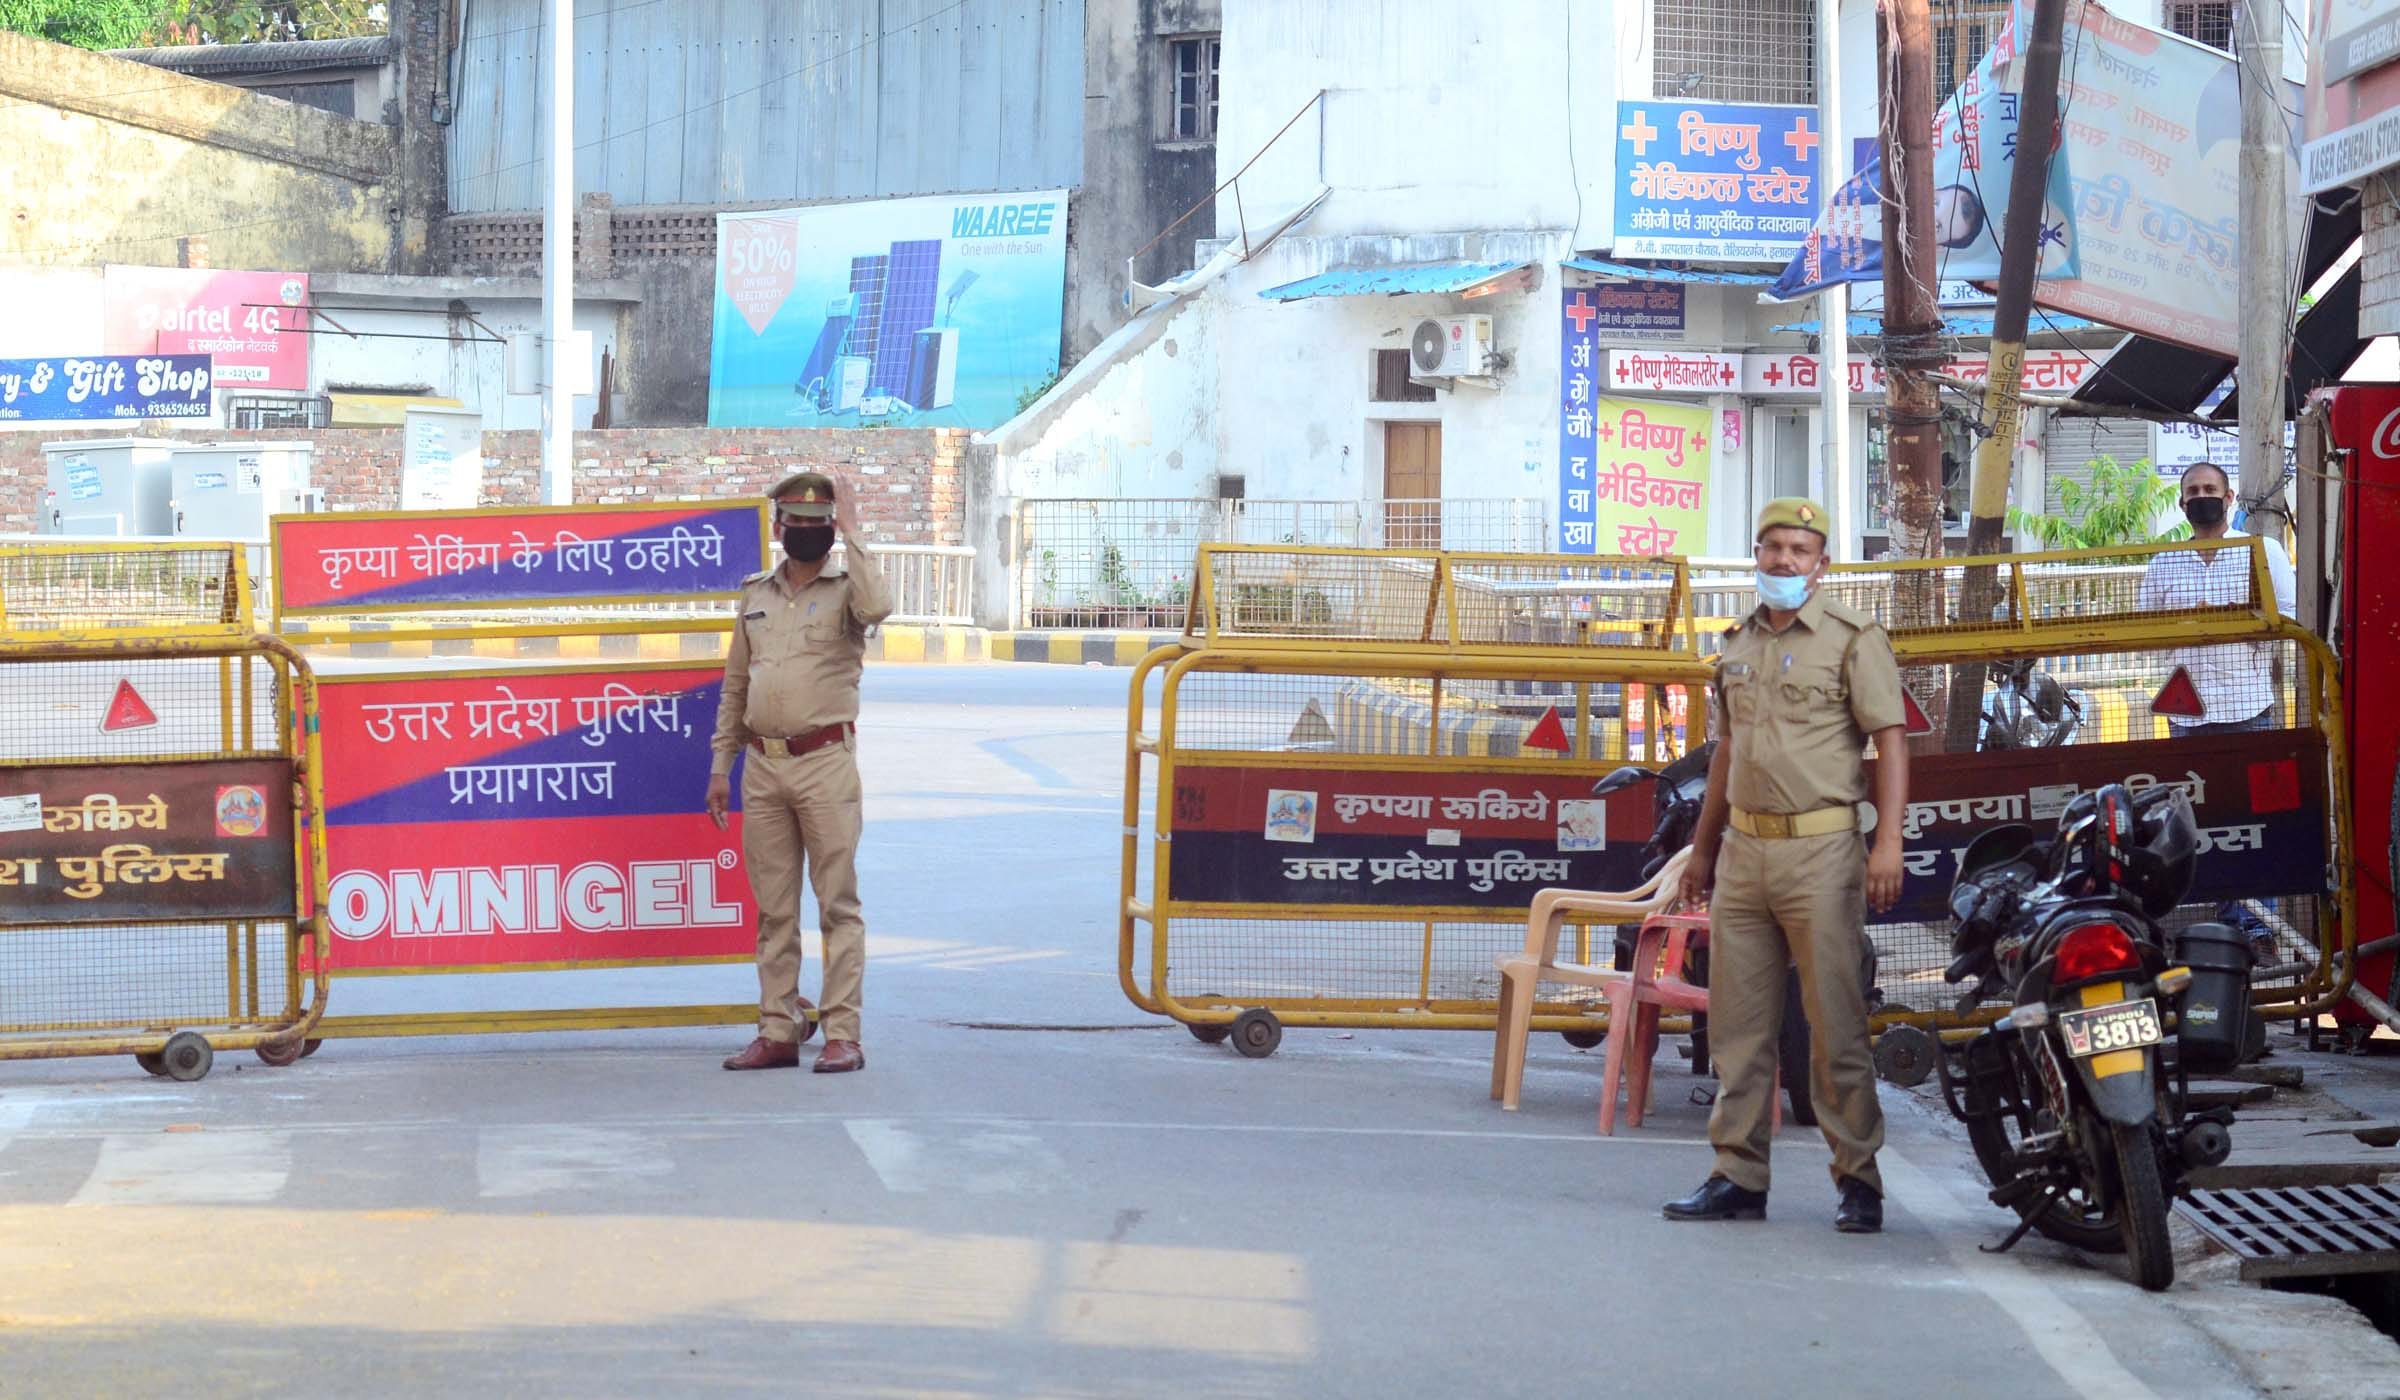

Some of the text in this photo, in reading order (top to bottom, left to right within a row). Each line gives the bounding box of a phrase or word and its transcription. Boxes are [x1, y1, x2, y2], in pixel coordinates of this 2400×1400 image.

[1677, 110, 1761, 171] विष्णु
[2336, 126, 2374, 172] GENERAL
[1630, 162, 1811, 204] मेडिकल स्टोर
[952, 203, 1056, 239] WAAREE
[1630, 207, 1670, 231] अंग्रेजी
[1672, 208, 1691, 232] एवं
[1694, 209, 1755, 237] आयुर्वेदिक
[1757, 215, 1811, 233] दवाखाना
[730, 236, 792, 275] 50%
[961, 241, 1042, 256] One with the Sun
[162, 305, 281, 335] airtel 4G
[197, 335, 245, 354] स्मार्टफोन
[247, 338, 279, 354] नेटवर्क
[30, 362, 54, 394] &
[64, 358, 125, 403] Gift
[136, 358, 209, 400] Shop
[1631, 354, 1663, 391] विष्णु
[115, 403, 138, 417] Mob.
[147, 403, 207, 417] 9336526455
[1620, 408, 1686, 467] विष्णु
[1597, 462, 1703, 510] मेडिकल
[319, 524, 724, 590] कृप्या चेकिंग के लिए ठहरिये
[1617, 516, 1678, 556] स्टोर
[362, 682, 692, 747] उत्तर प्रदेश पुलिस,
[445, 762, 616, 805] प्रयागराज
[1333, 792, 1433, 824] कृपया
[1903, 793, 2027, 840] कृपया
[56, 843, 230, 899] पुलिस
[1283, 849, 1571, 893] उत्तर प्रदेश पुलिस
[2092, 1016, 2158, 1050] 3813
